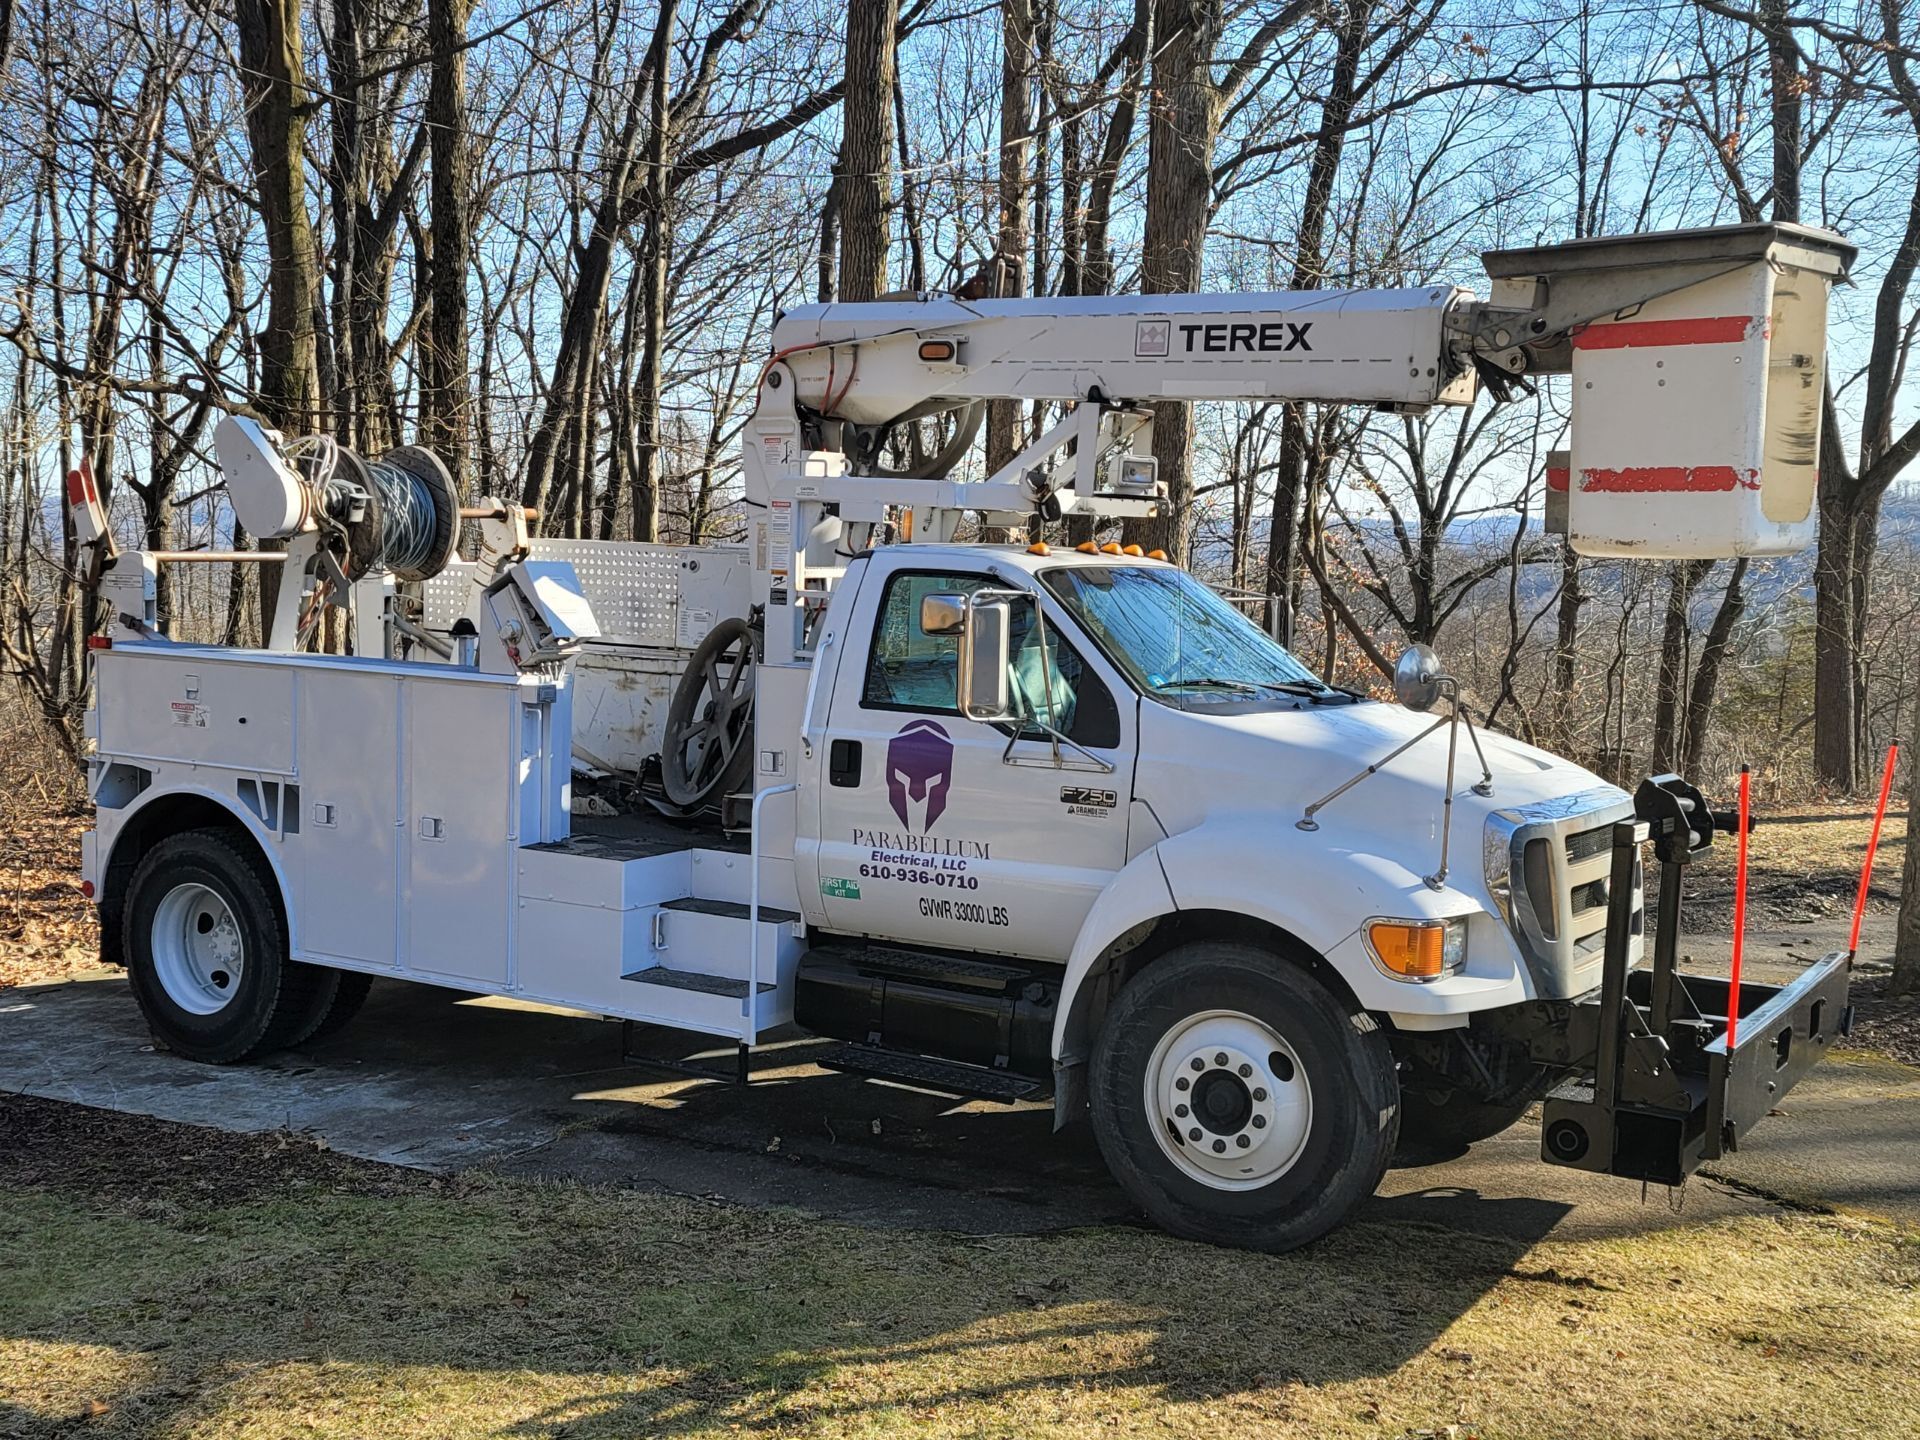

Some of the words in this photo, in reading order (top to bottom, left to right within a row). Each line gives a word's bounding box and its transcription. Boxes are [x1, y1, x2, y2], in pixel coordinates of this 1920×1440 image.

[1179, 322, 1313, 352] TEREX
[852, 828, 991, 860] PARABELLUM
[871, 850, 938, 870] Electrical,
[941, 858, 967, 871] LLC
[821, 877, 843, 888] FIRST
[845, 880, 860, 890] AID
[859, 864, 978, 890] 610-936-0710
[834, 889, 847, 897] KIT
[919, 897, 953, 919] GVWR
[954, 901, 984, 923] 33000
[986, 905, 1009, 926] LBS
